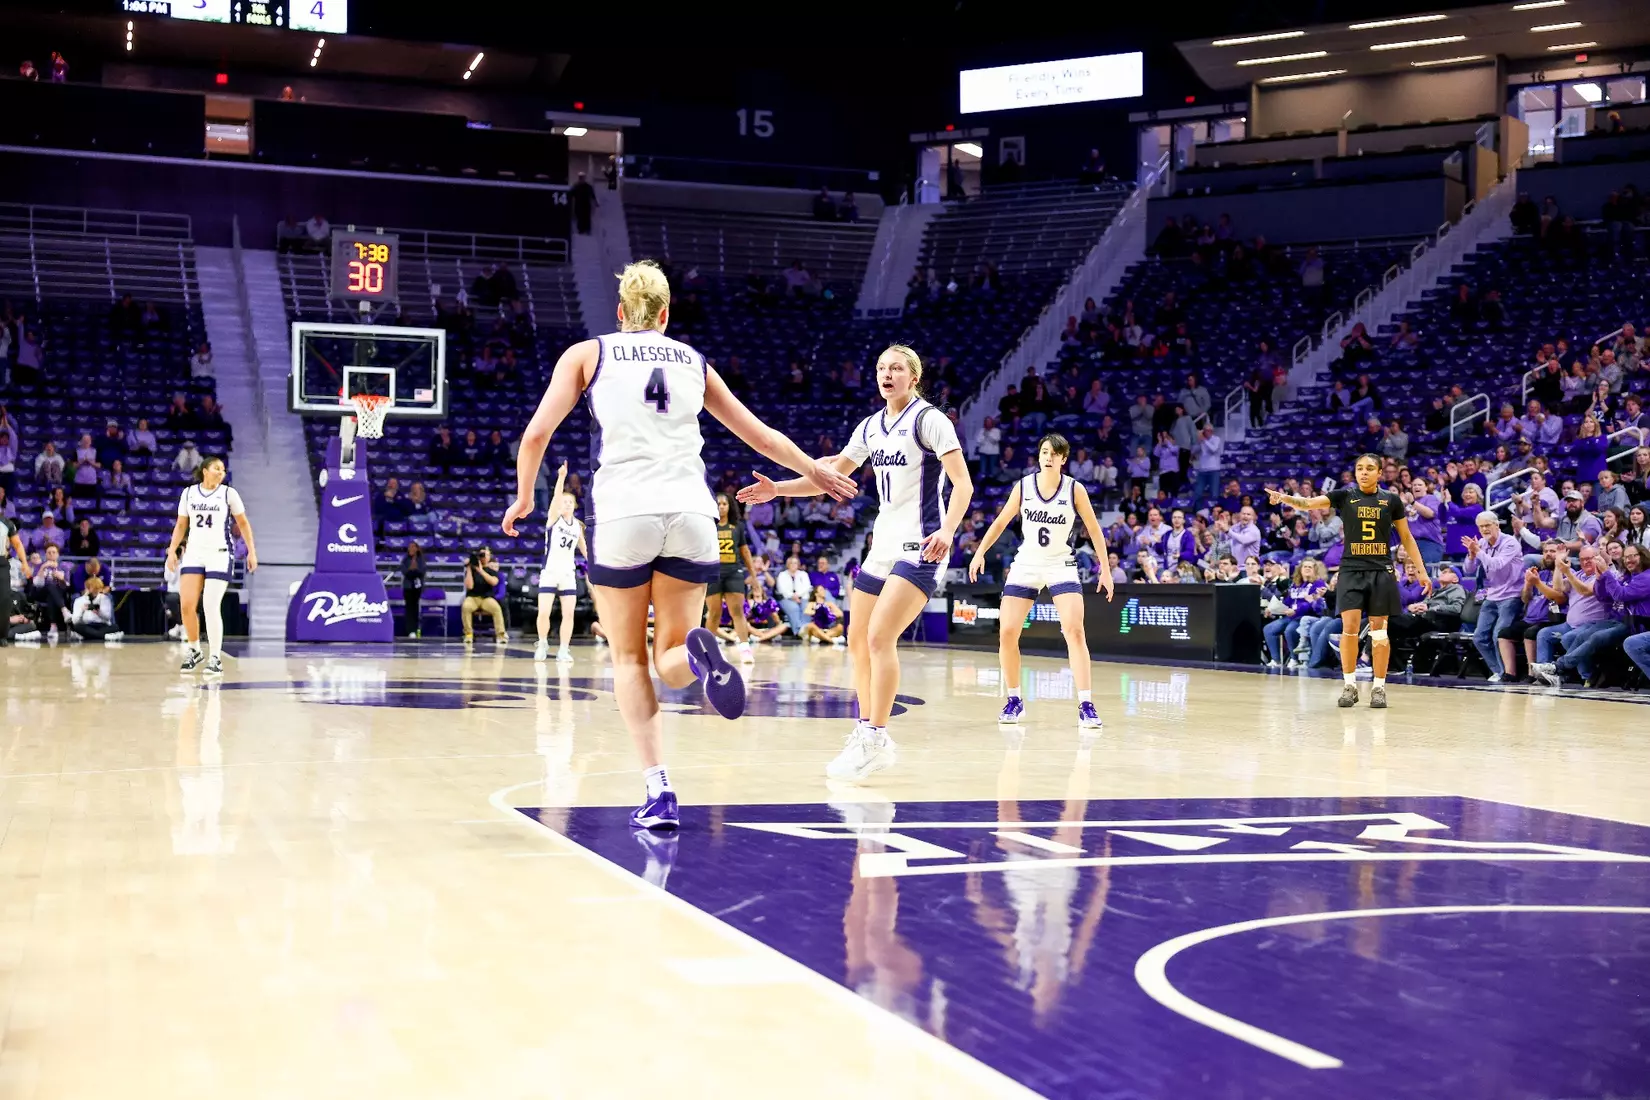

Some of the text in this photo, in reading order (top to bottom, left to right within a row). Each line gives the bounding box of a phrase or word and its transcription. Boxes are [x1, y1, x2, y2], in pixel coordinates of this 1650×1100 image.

[148, 2, 168, 14] PM
[310, 1, 325, 19] 4
[1008, 72, 1056, 84] Frendly
[736, 108, 774, 137] 15
[552, 191, 568, 205] 14
[354, 242, 389, 263] 7:38
[348, 261, 383, 292] 30
[613, 345, 692, 365] CLAESSENS
[644, 367, 670, 413] 4
[881, 470, 891, 503] 11
[190, 502, 220, 512] Wildcats
[1024, 508, 1067, 525] Wildcats
[1357, 506, 1381, 520] WEST
[196, 514, 213, 528] 24
[1361, 520, 1376, 541] 5
[560, 536, 574, 551] 34
[1038, 526, 1050, 548] 6
[327, 543, 368, 553] Channel
[303, 590, 389, 625] Dillons
[1139, 606, 1189, 626] INTRUST
